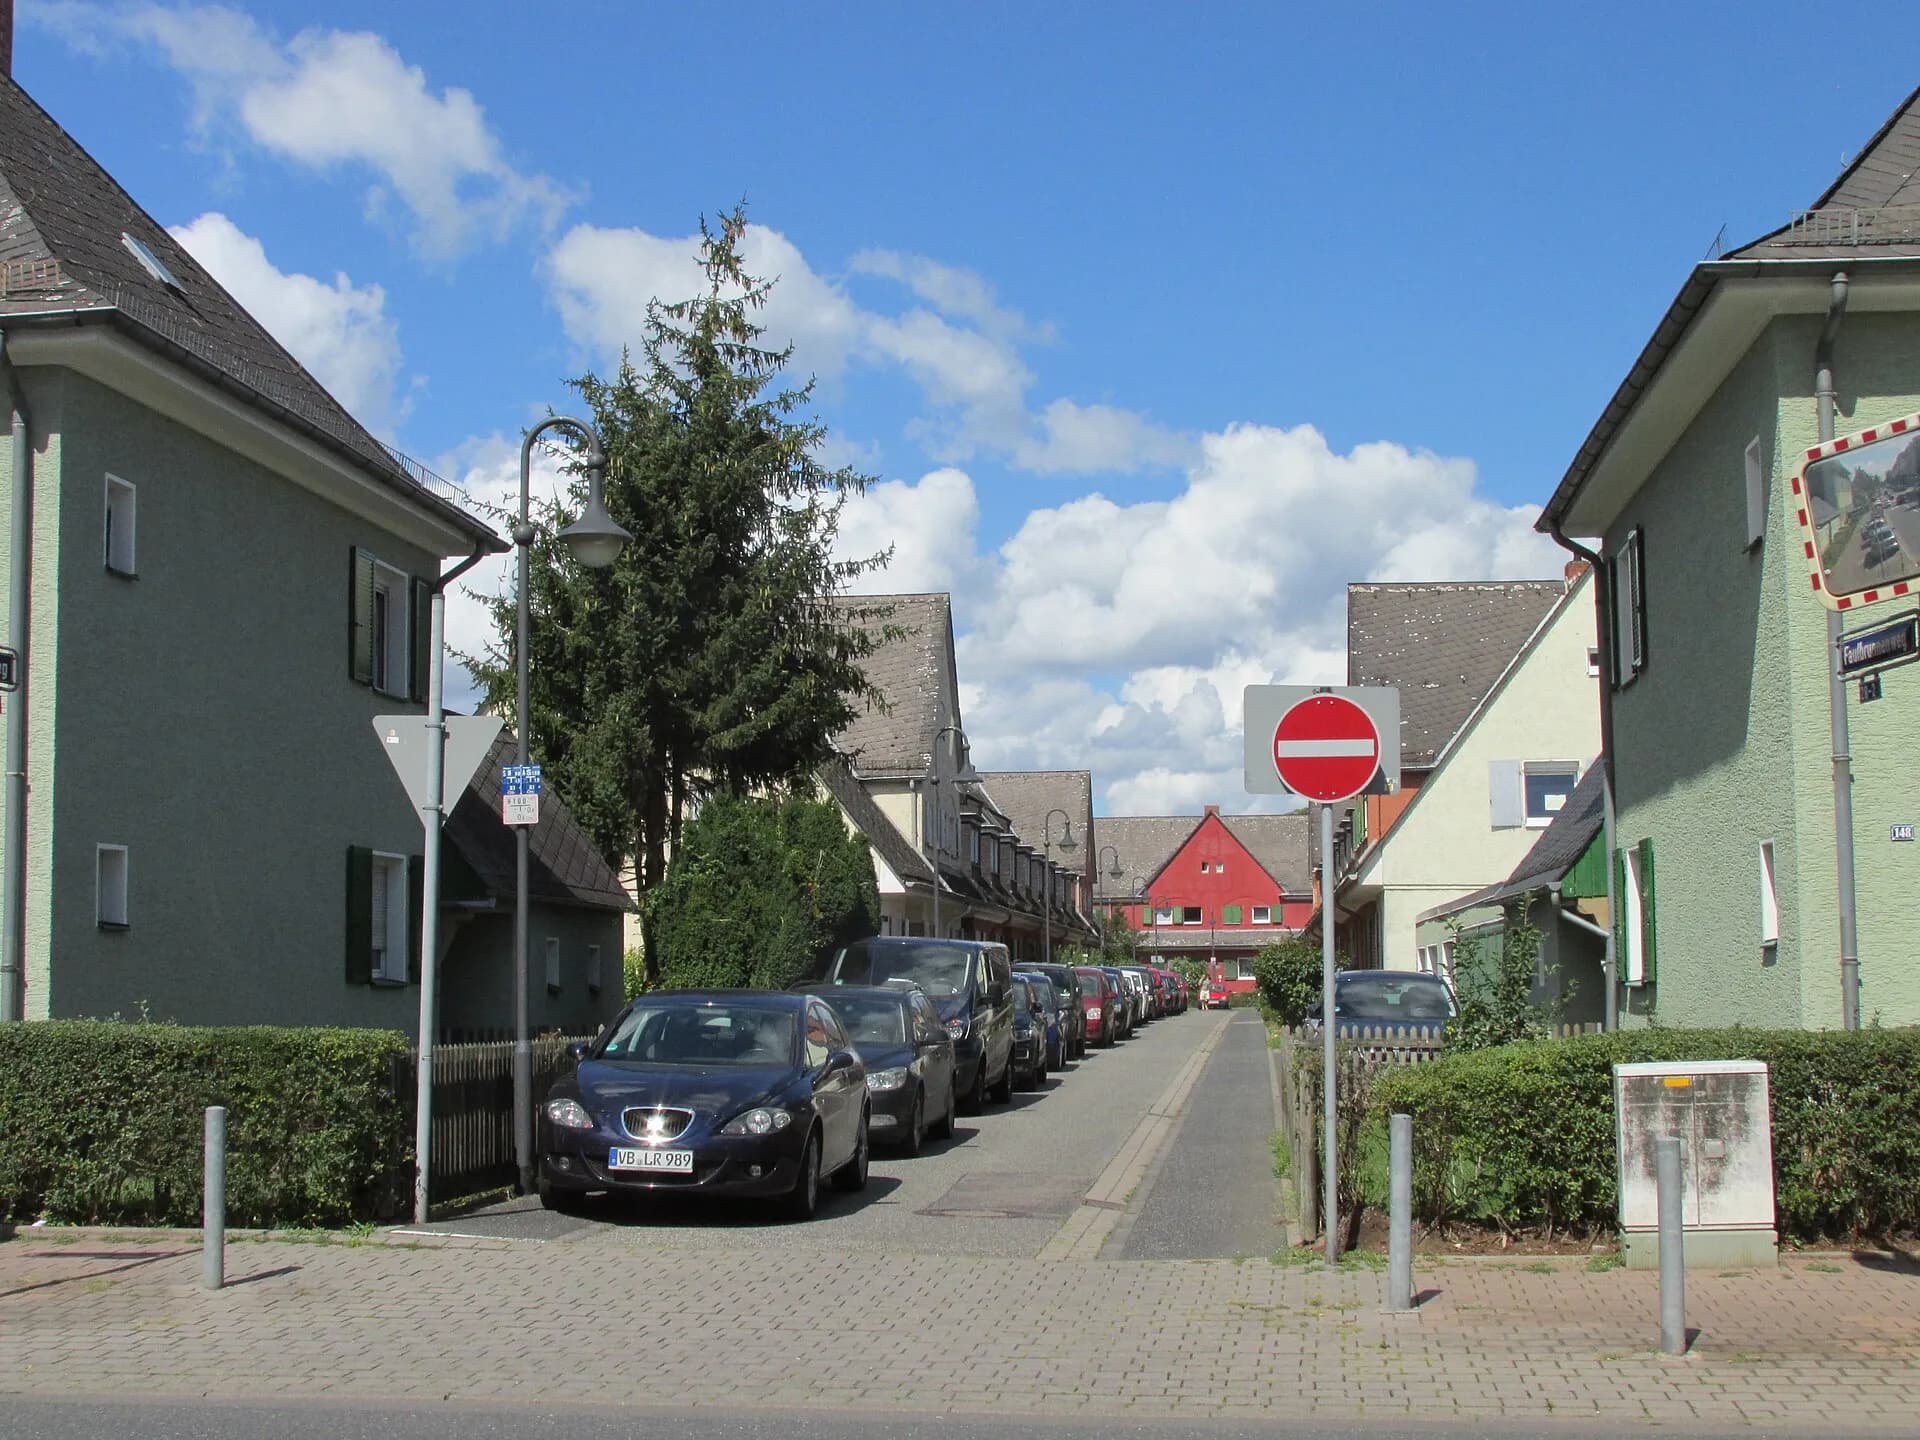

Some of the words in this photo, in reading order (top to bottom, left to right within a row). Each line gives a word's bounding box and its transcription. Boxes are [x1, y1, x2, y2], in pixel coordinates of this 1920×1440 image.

[1894, 827, 1911, 838] 148
[619, 1151, 635, 1165] VB
[644, 1152, 661, 1166] LR
[665, 1153, 691, 1167] 989
